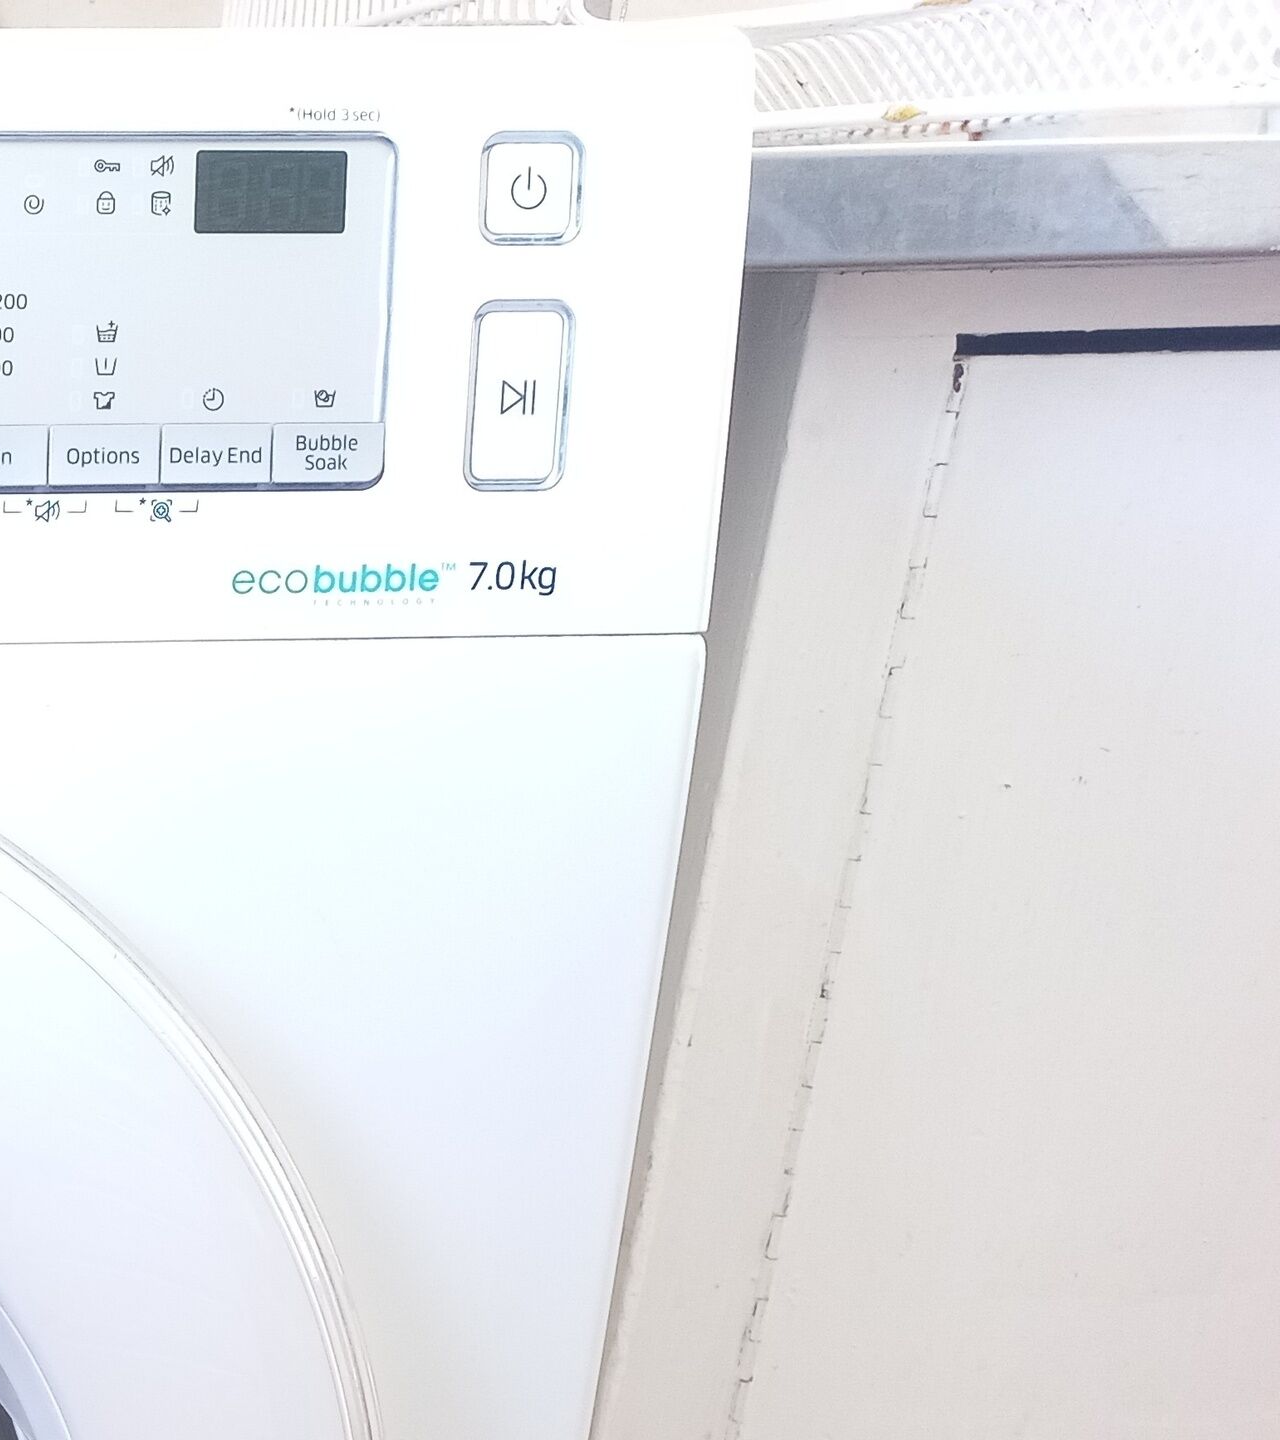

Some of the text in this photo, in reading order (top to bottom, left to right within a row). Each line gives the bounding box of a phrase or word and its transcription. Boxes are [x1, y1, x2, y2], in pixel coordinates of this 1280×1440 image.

[341, 108, 349, 121] 3
[353, 108, 381, 123] sec)
[296, 435, 358, 451] Bubble
[66, 447, 140, 468] Options
[170, 447, 262, 467] Delay End
[305, 454, 347, 471] Soak
